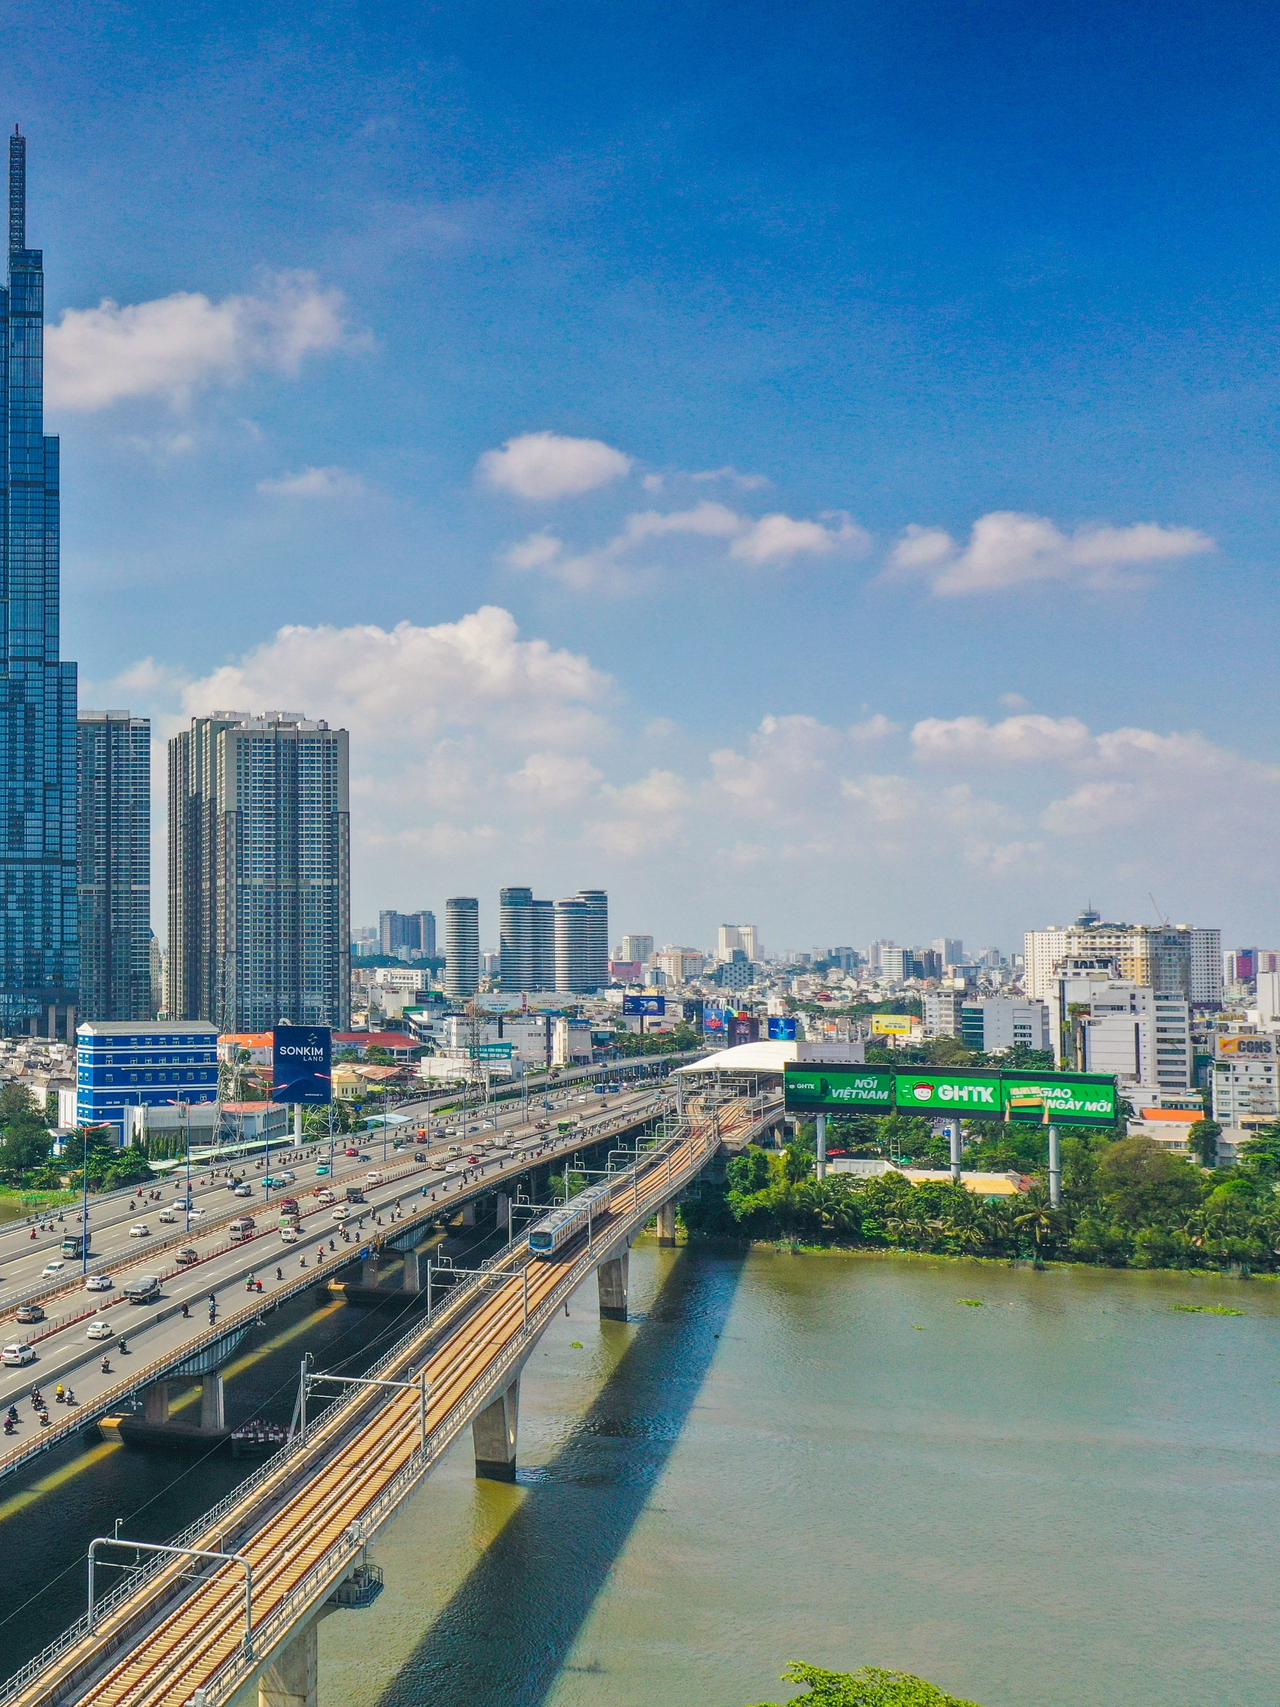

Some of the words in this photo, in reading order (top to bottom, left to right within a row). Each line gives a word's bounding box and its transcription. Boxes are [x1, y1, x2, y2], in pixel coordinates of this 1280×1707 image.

[279, 1046, 324, 1056] SONKIM
[854, 1076, 879, 1089] NỐI
[937, 1084, 995, 1103] GHTK
[1047, 1097, 1084, 1110] NGÀY
[1084, 1099, 1112, 1112] MỚI
